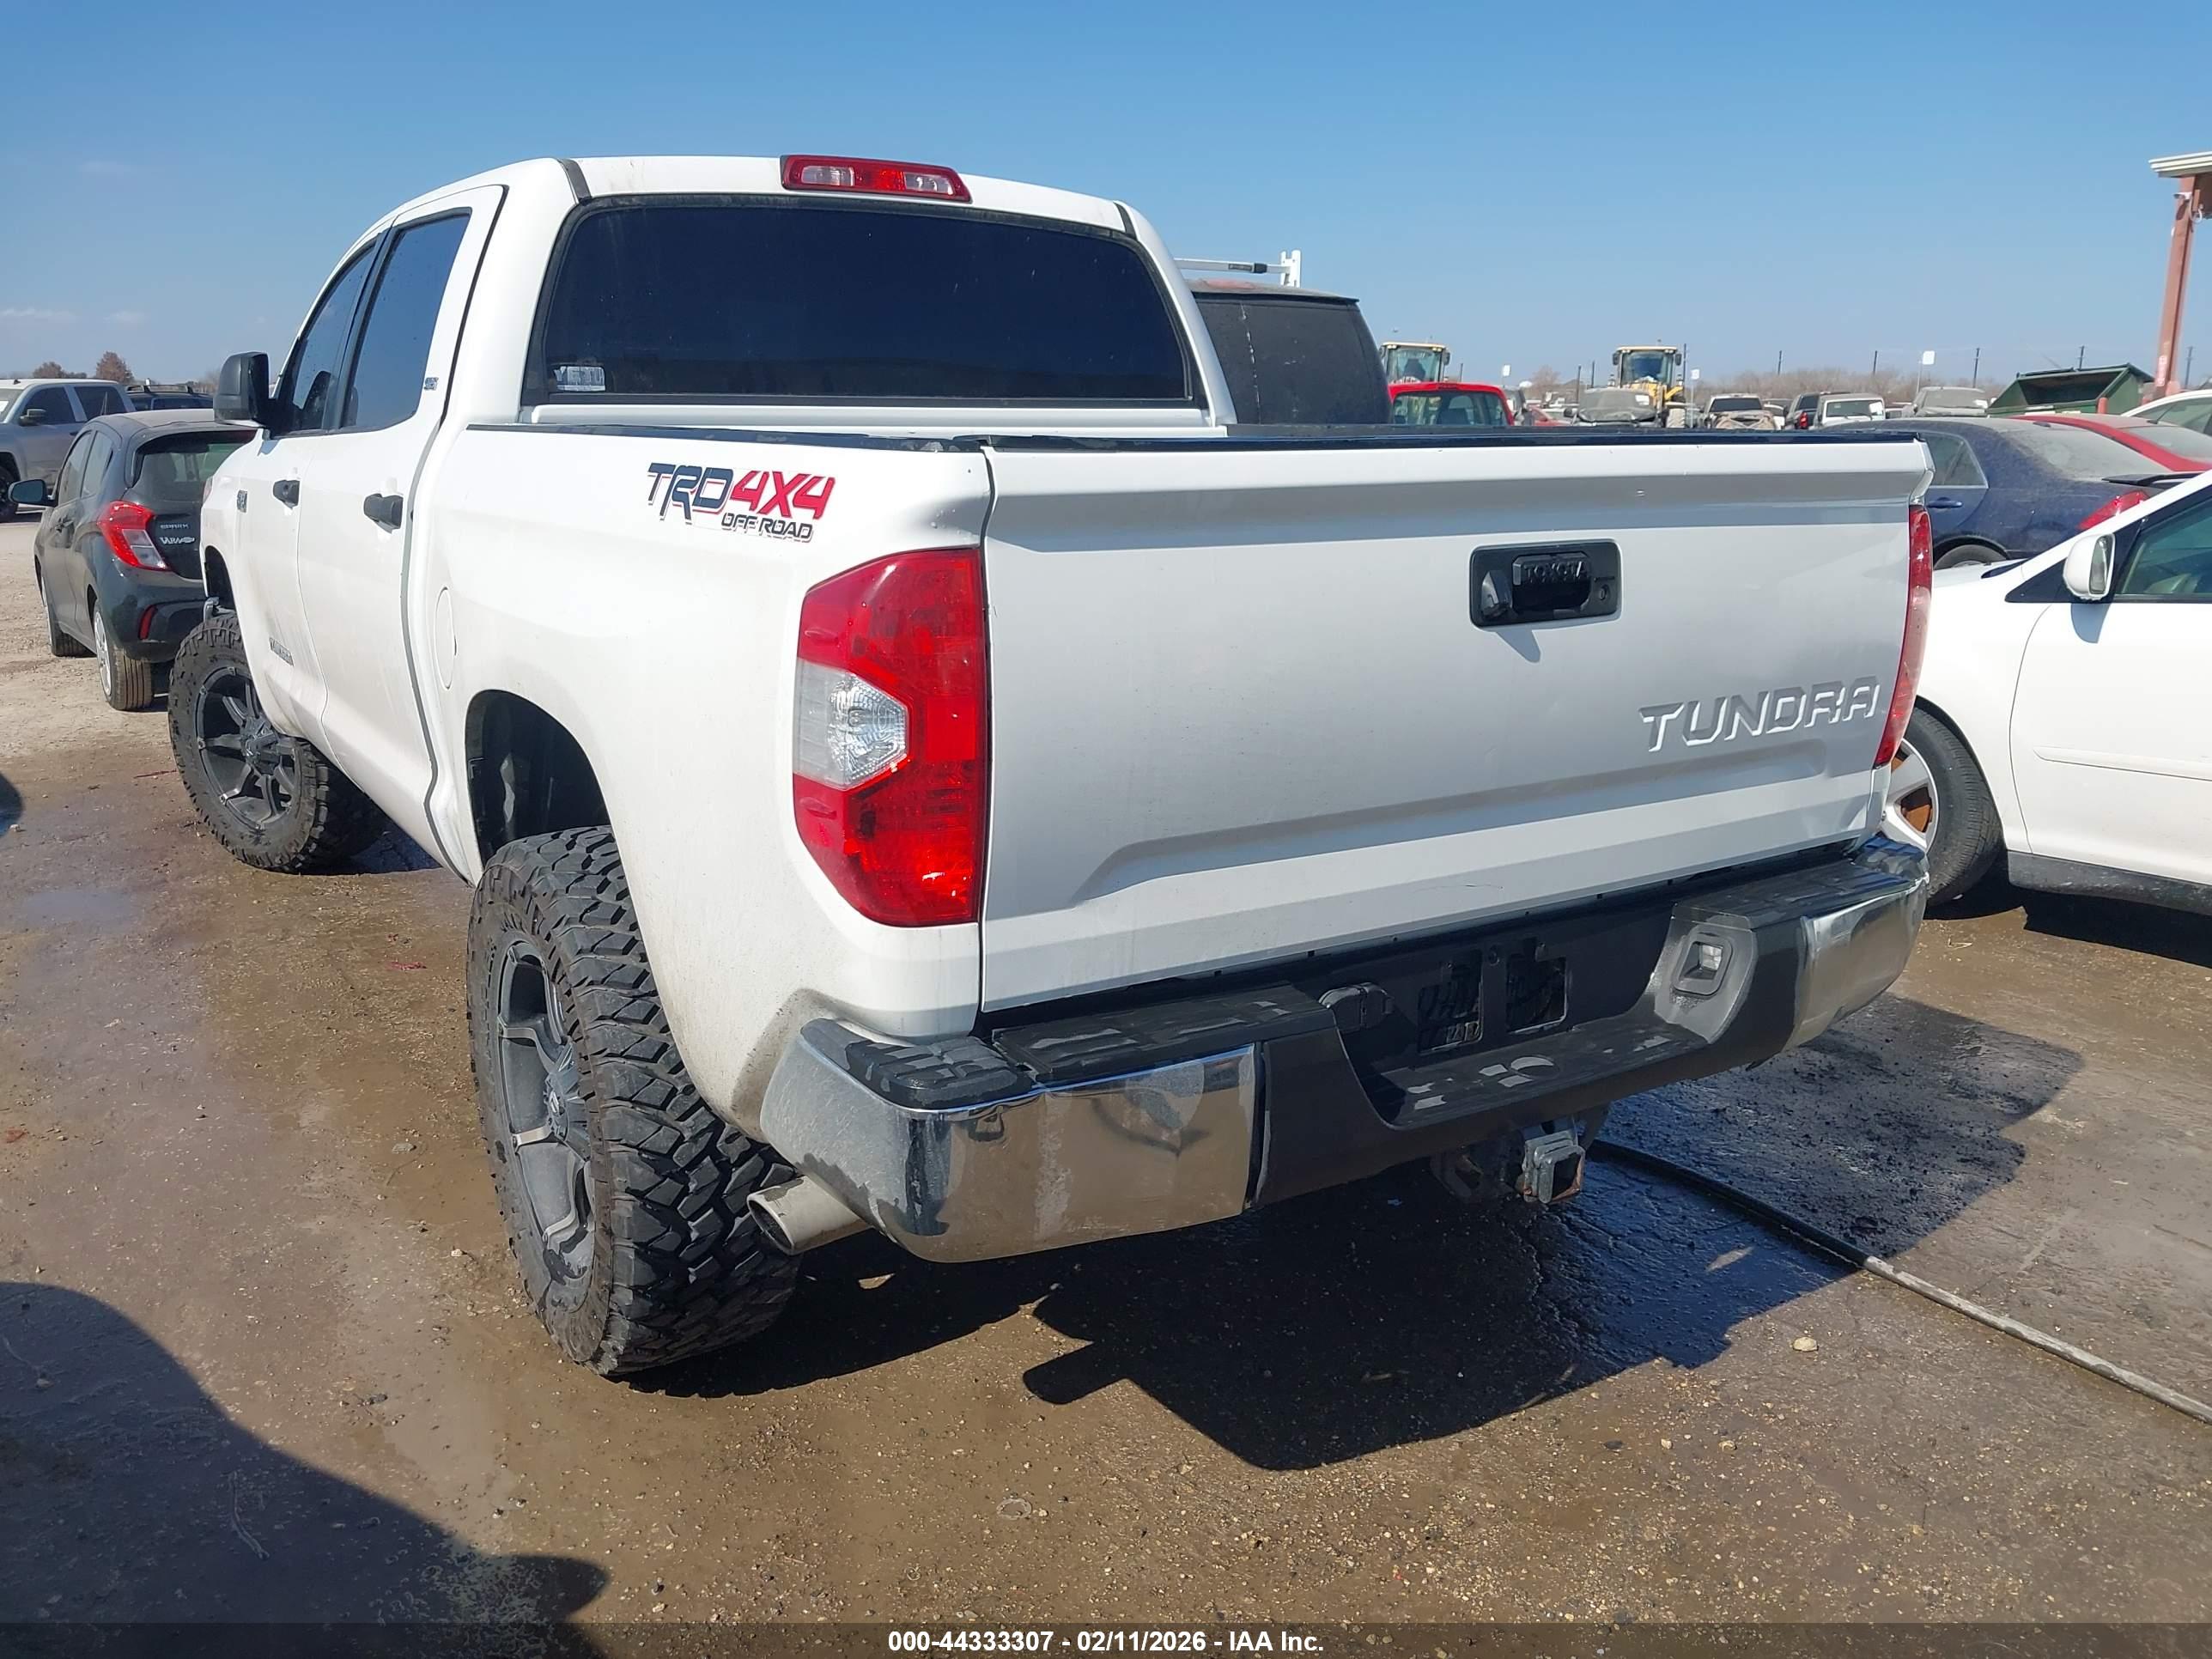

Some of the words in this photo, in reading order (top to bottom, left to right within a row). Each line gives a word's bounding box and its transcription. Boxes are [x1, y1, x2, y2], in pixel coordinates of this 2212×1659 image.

[647, 462, 733, 525] TRD
[721, 513, 758, 533] OFF
[758, 517, 813, 543] ROAD
[1524, 560, 1588, 583] TOYOTA
[1638, 675, 1880, 752] TUNDRA
